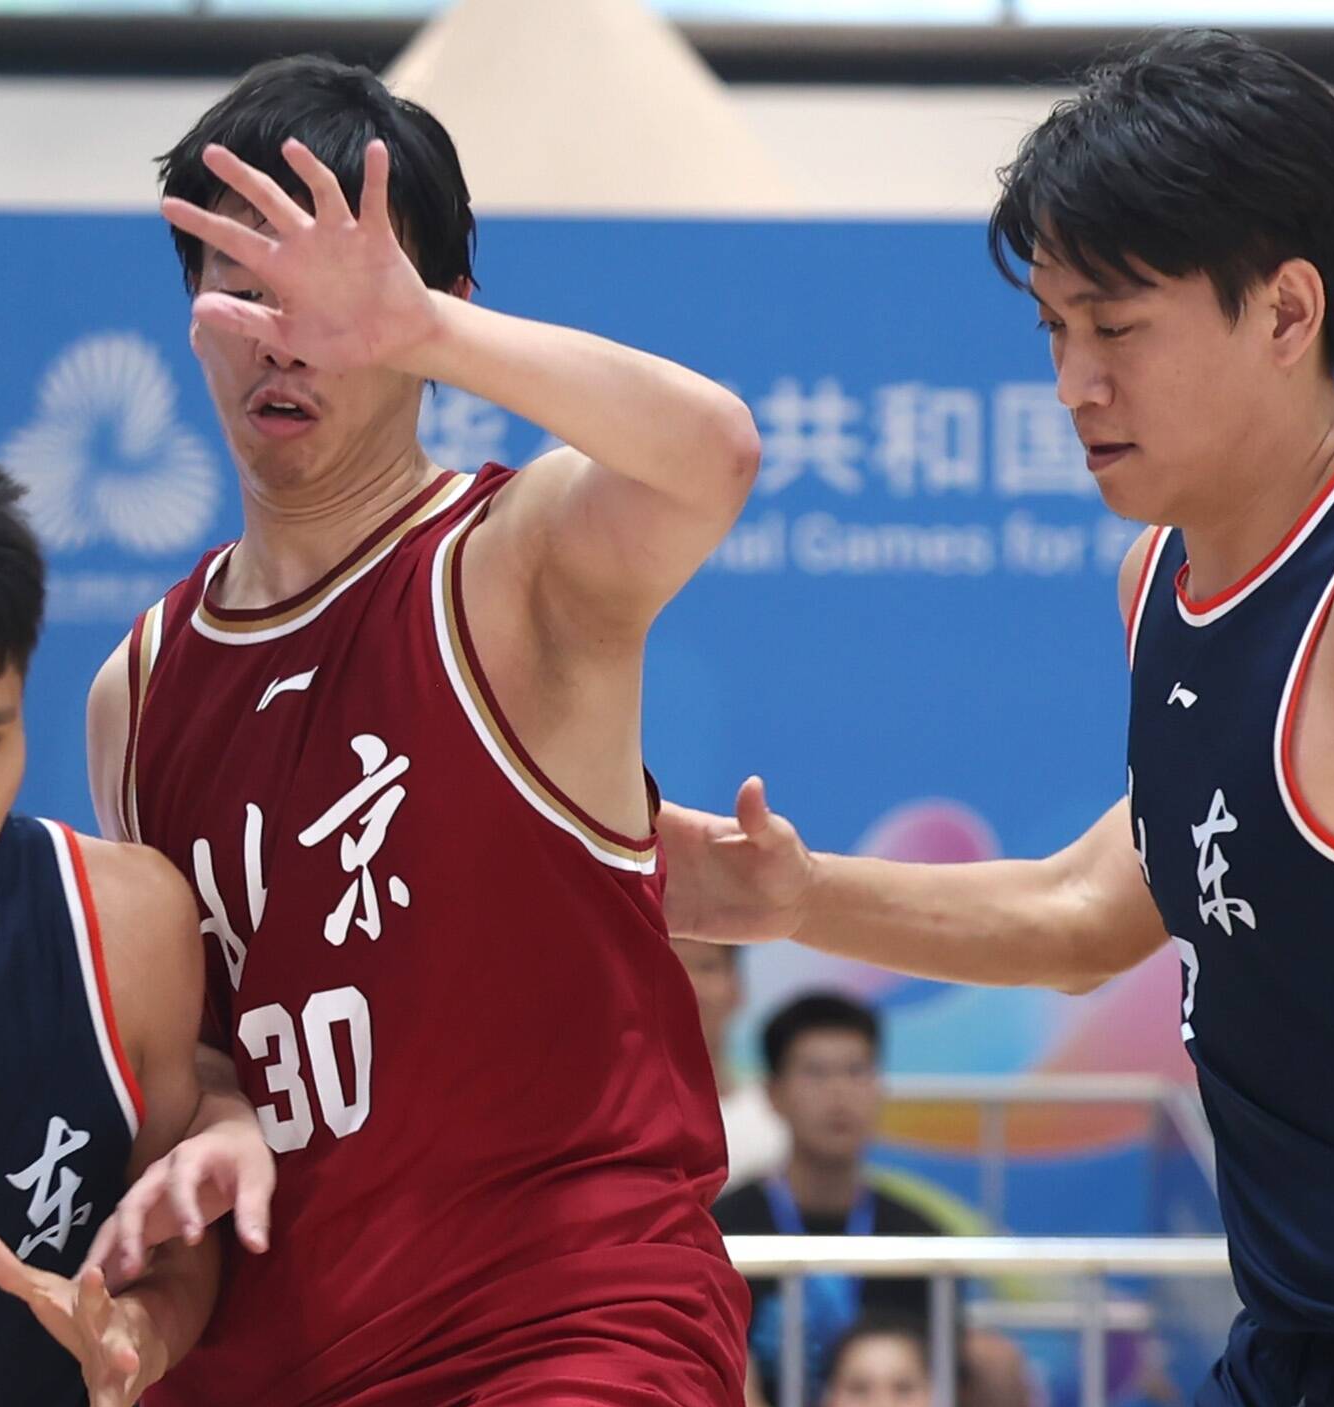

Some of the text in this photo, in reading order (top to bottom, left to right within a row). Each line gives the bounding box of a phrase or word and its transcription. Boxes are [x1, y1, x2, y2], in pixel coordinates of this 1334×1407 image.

[759, 378, 1097, 500] 共和国
[790, 510, 997, 577] Games
[1003, 510, 1087, 577] for
[237, 986, 373, 1154] 30
